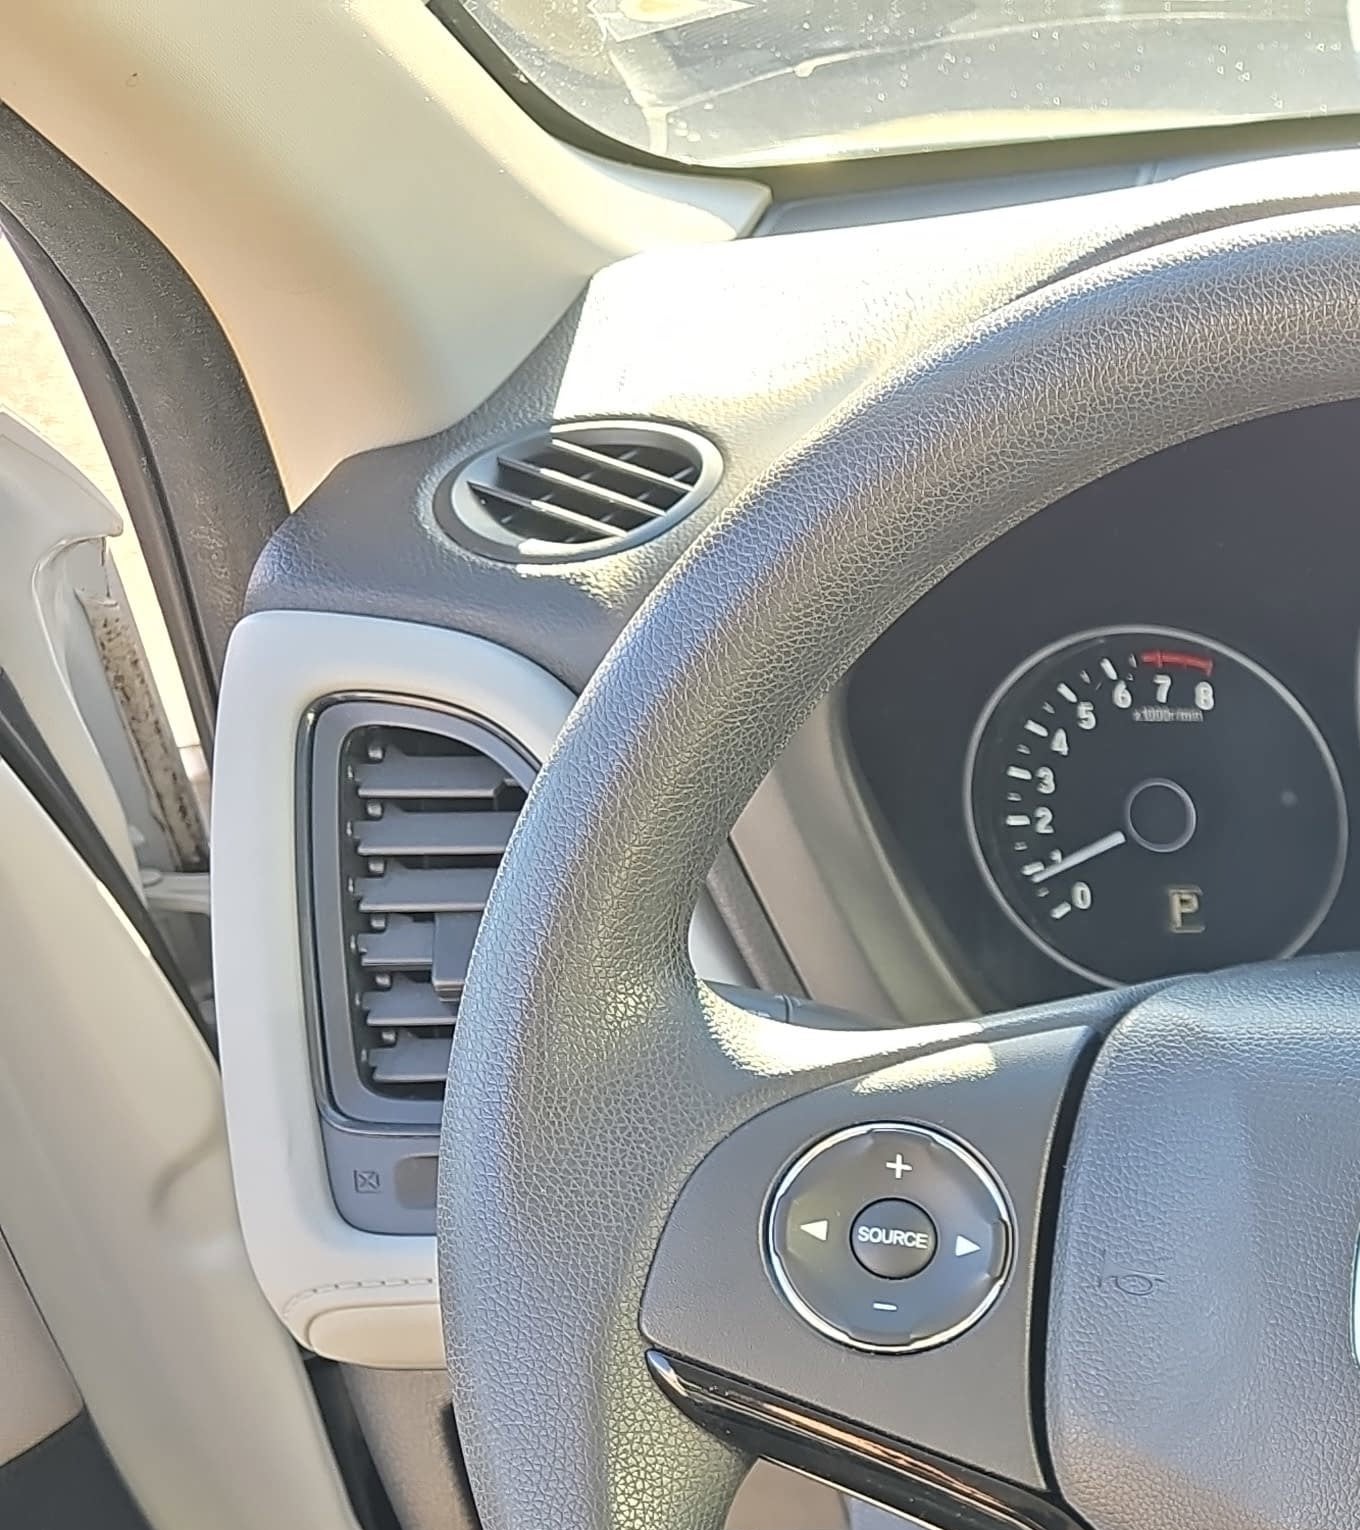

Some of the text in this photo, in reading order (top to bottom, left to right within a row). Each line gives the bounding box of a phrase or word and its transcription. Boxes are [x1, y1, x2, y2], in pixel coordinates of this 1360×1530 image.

[1113, 681, 1132, 709] 6
[1153, 674, 1172, 703] 7
[1194, 681, 1214, 710] 8
[1076, 702, 1096, 730] 5
[1051, 728, 1069, 756] 4
[1035, 767, 1056, 794] 3
[1034, 807, 1055, 834] 2
[1071, 881, 1092, 910] 0
[1173, 890, 1201, 929] P
[857, 1225, 929, 1249] SOURCE
